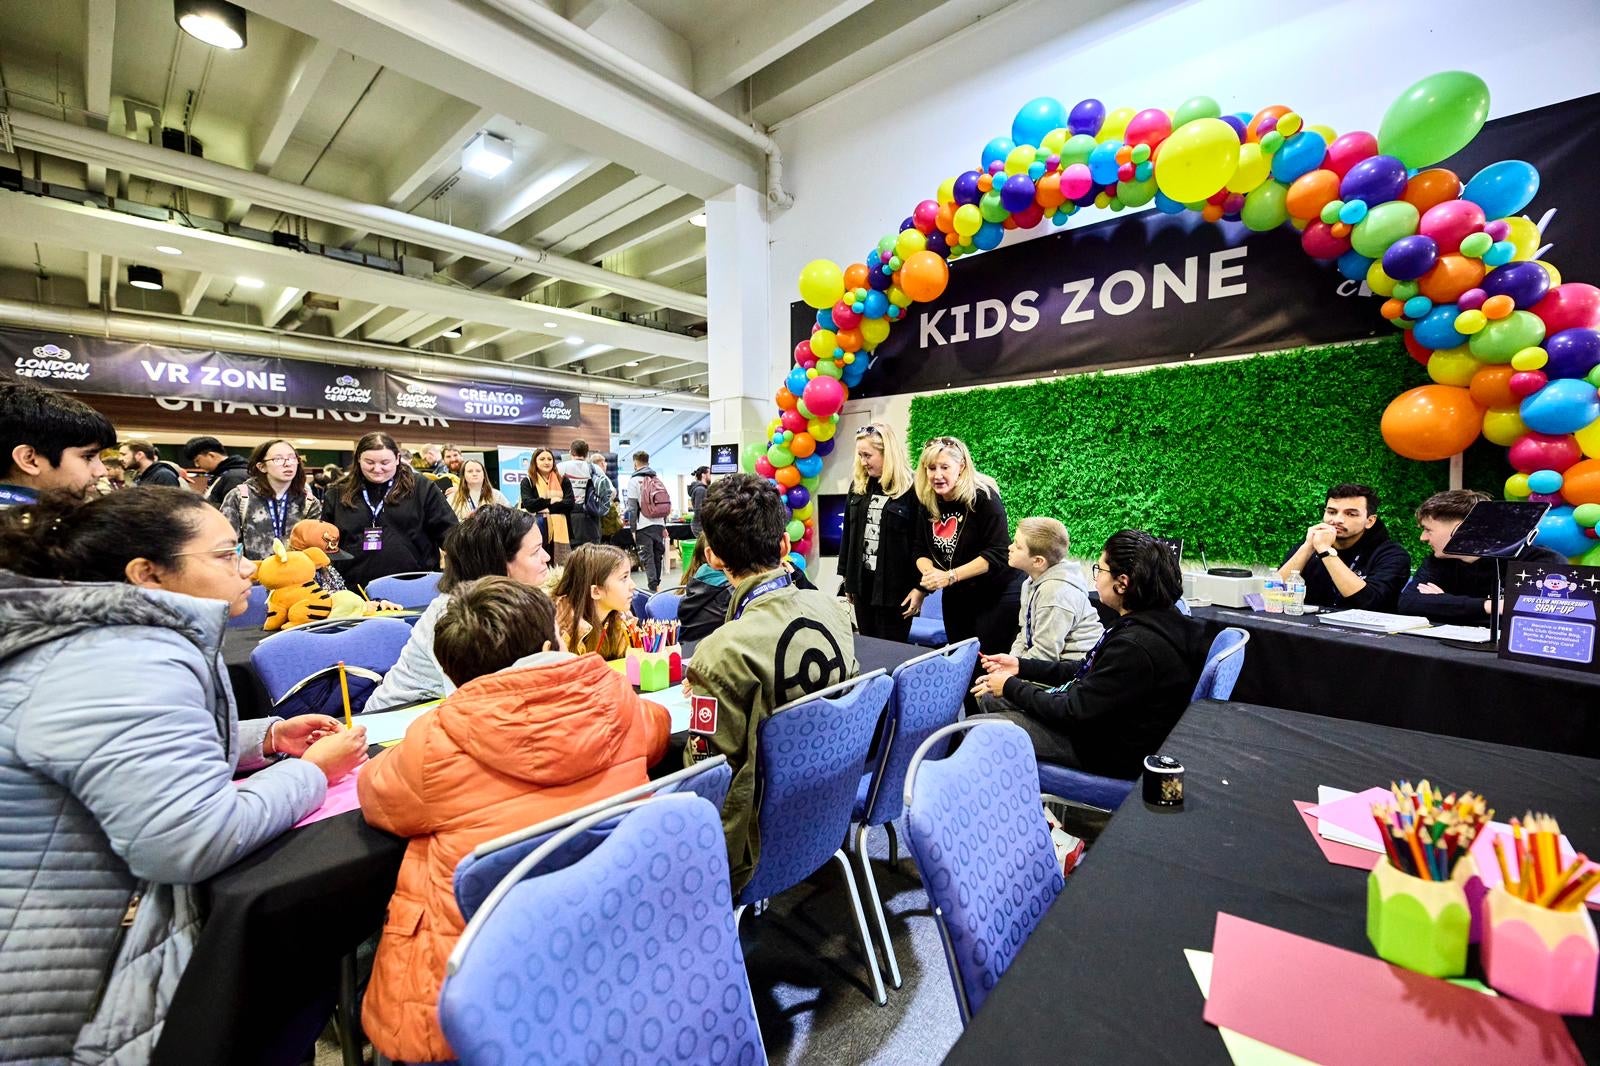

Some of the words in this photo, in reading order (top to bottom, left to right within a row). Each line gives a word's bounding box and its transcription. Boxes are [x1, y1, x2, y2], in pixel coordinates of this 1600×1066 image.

[919, 290, 1040, 349] KIDS
[1060, 245, 1248, 325] ZONE
[15, 356, 90, 374] LONDON
[51, 370, 90, 380] SHOW
[141, 360, 190, 384] VR
[200, 366, 287, 392] ZONE
[324, 385, 371, 397] LONDON
[458, 388, 524, 405] CREATOR
[347, 395, 371, 404] SHOW
[396, 392, 437, 404] LONDON
[464, 401, 520, 417] STUDIO
[542, 406, 572, 415] LONDON
[1535, 603, 1575, 615] SIGN-UP
[1542, 645, 1557, 654] £2
